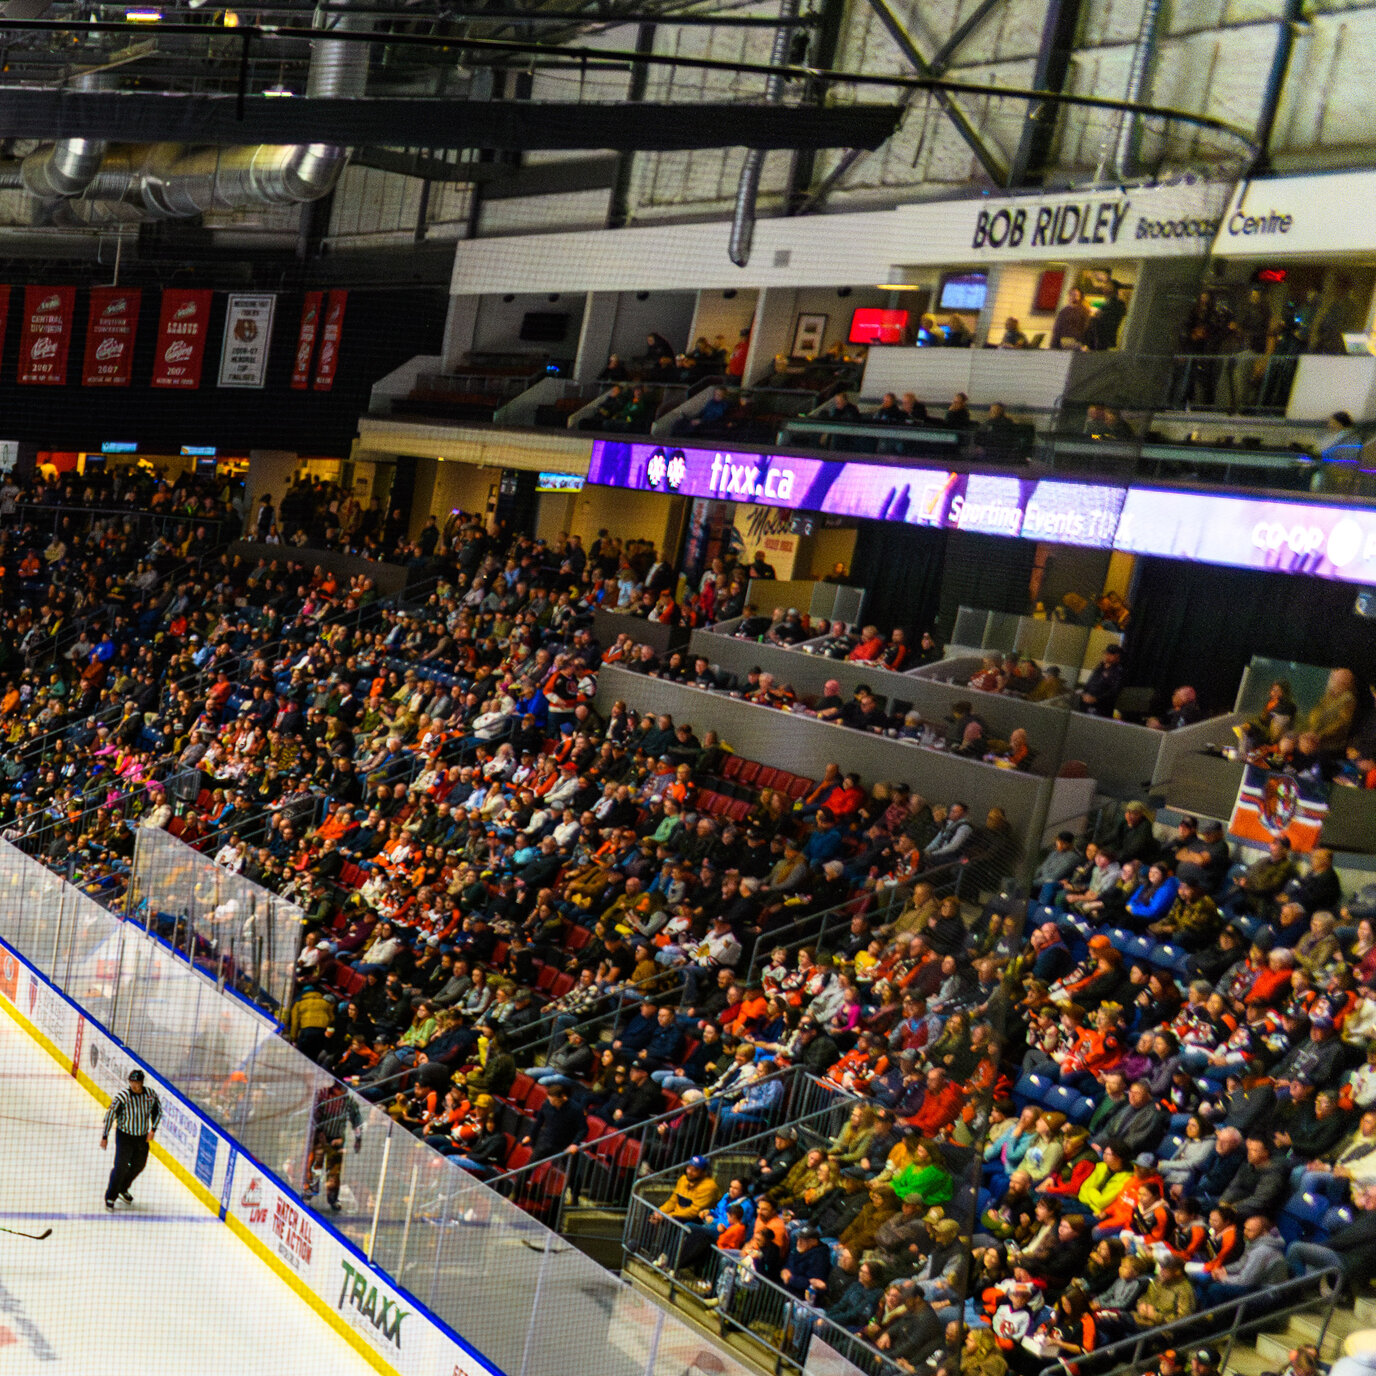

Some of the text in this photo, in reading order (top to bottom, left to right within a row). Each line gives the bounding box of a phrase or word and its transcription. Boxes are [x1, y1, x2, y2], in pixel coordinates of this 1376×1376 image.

[972, 209, 1025, 249] BOB
[1031, 200, 1132, 247] RIDLEY
[1227, 208, 1293, 236] Centre
[948, 494, 1022, 538] Sporting
[1023, 504, 1084, 535] Events
[249, 1207, 269, 1224] LIVE
[272, 1213, 285, 1240] THE
[286, 1223, 313, 1266] ACTION
[276, 1195, 313, 1245] WATCH ALL
[338, 1258, 413, 1350] TRAXX
